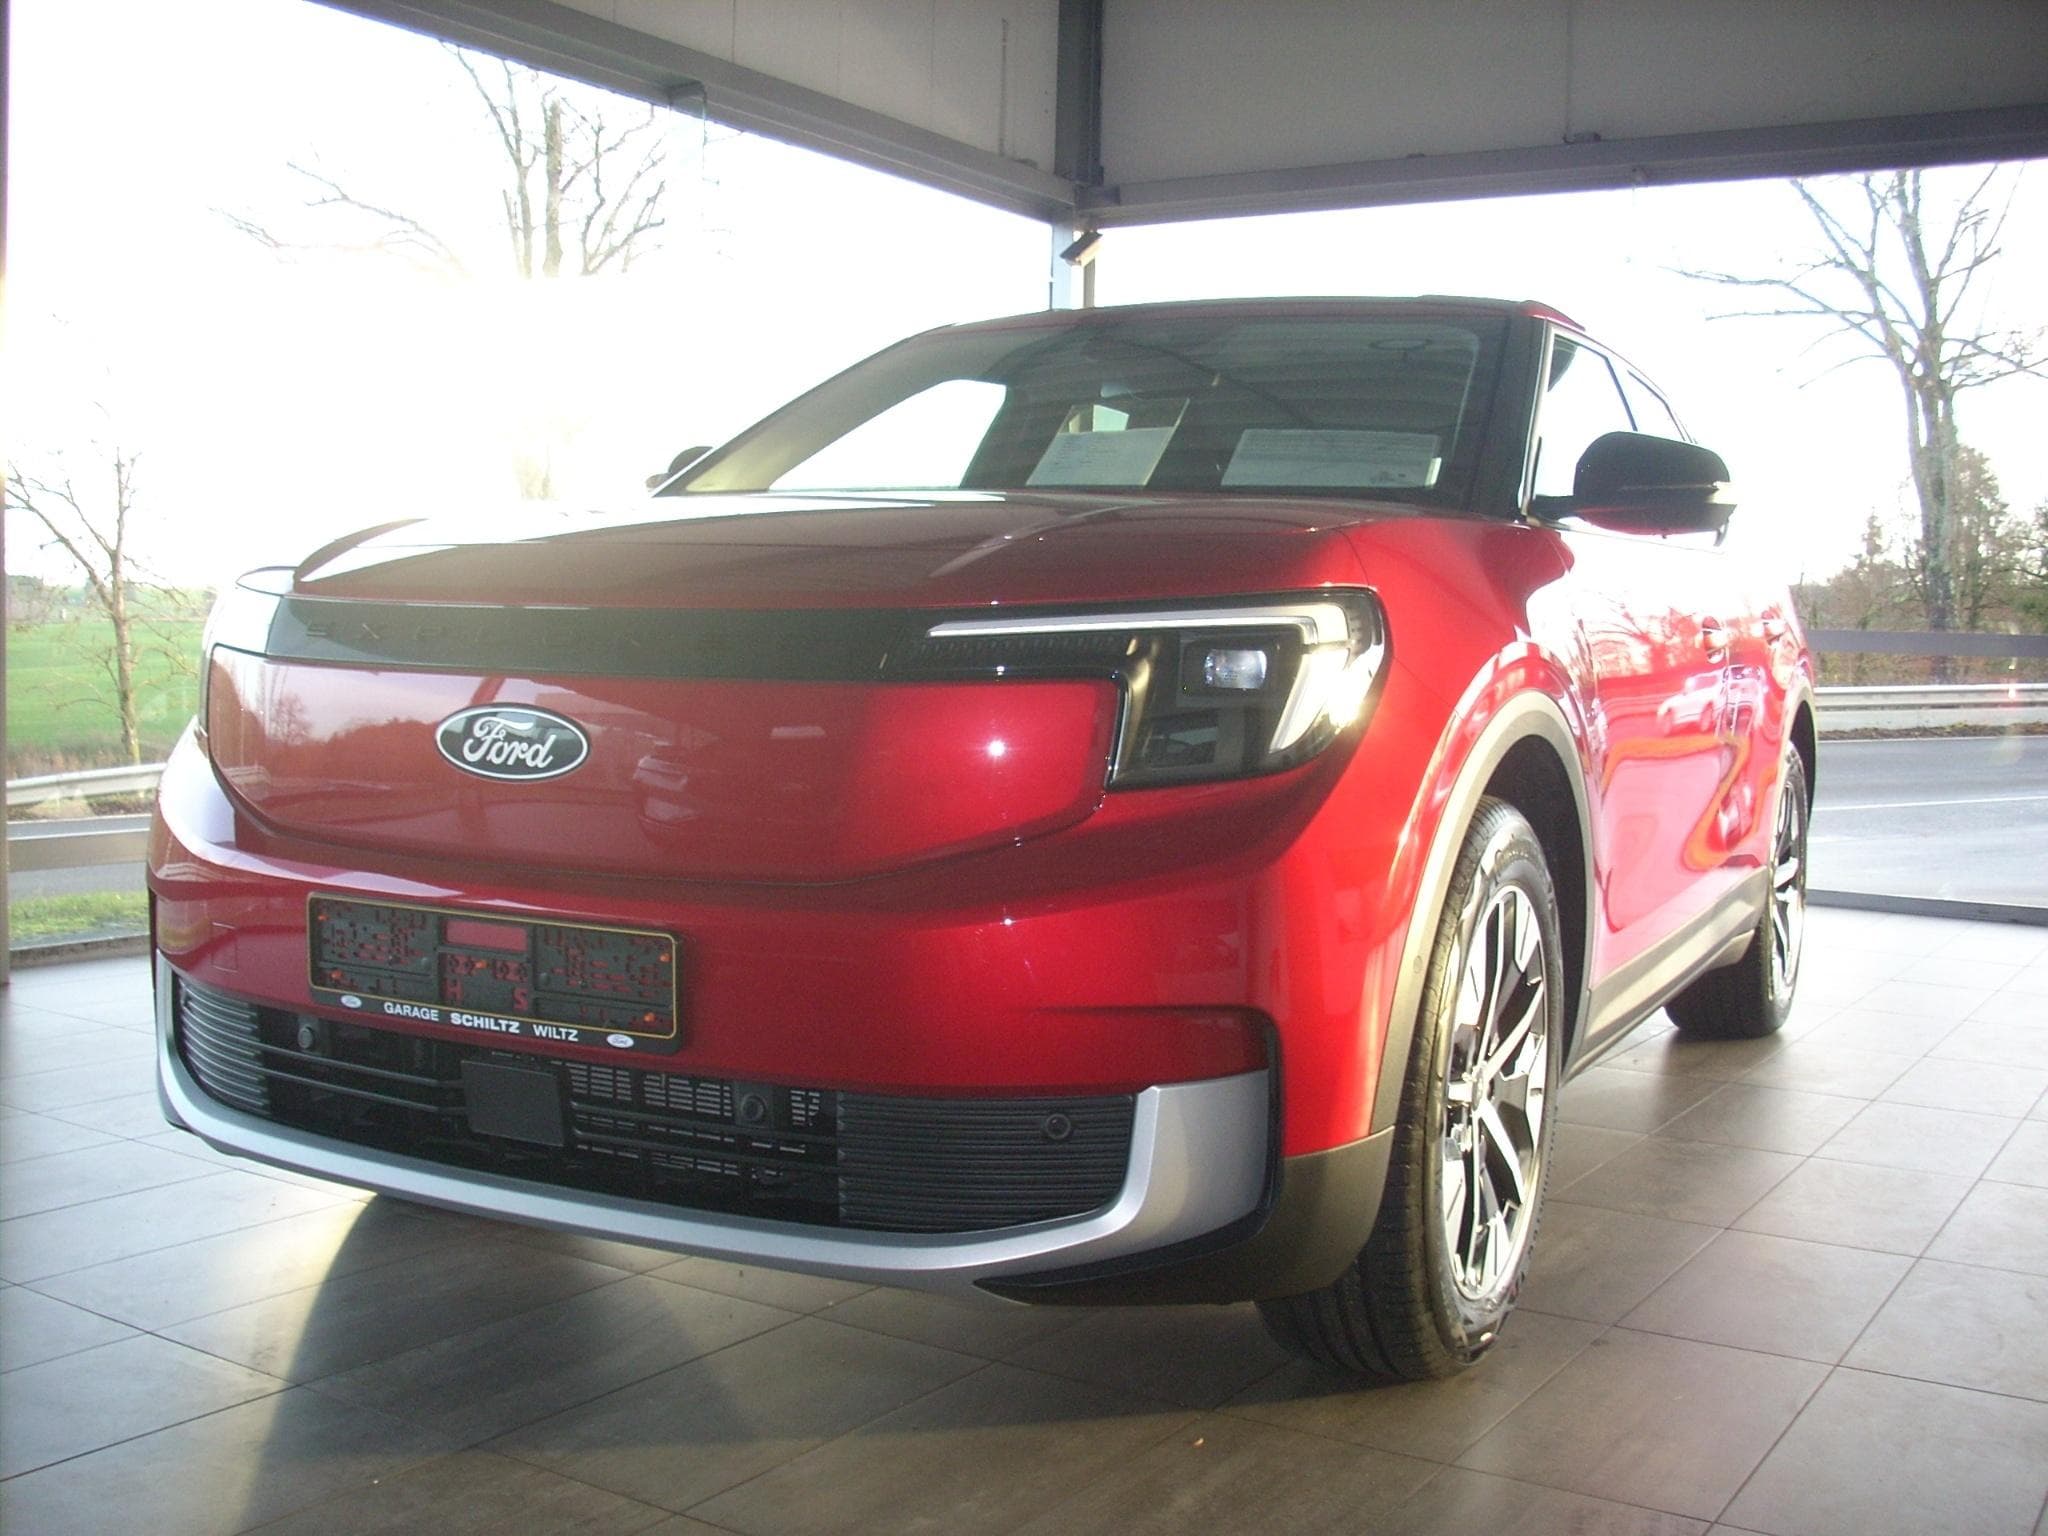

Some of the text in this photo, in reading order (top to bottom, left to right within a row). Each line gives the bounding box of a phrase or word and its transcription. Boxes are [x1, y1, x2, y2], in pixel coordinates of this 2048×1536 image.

[462, 718, 553, 768] Ford
[384, 1002, 578, 1041] GARAGE SCHILTZ WILTZ
